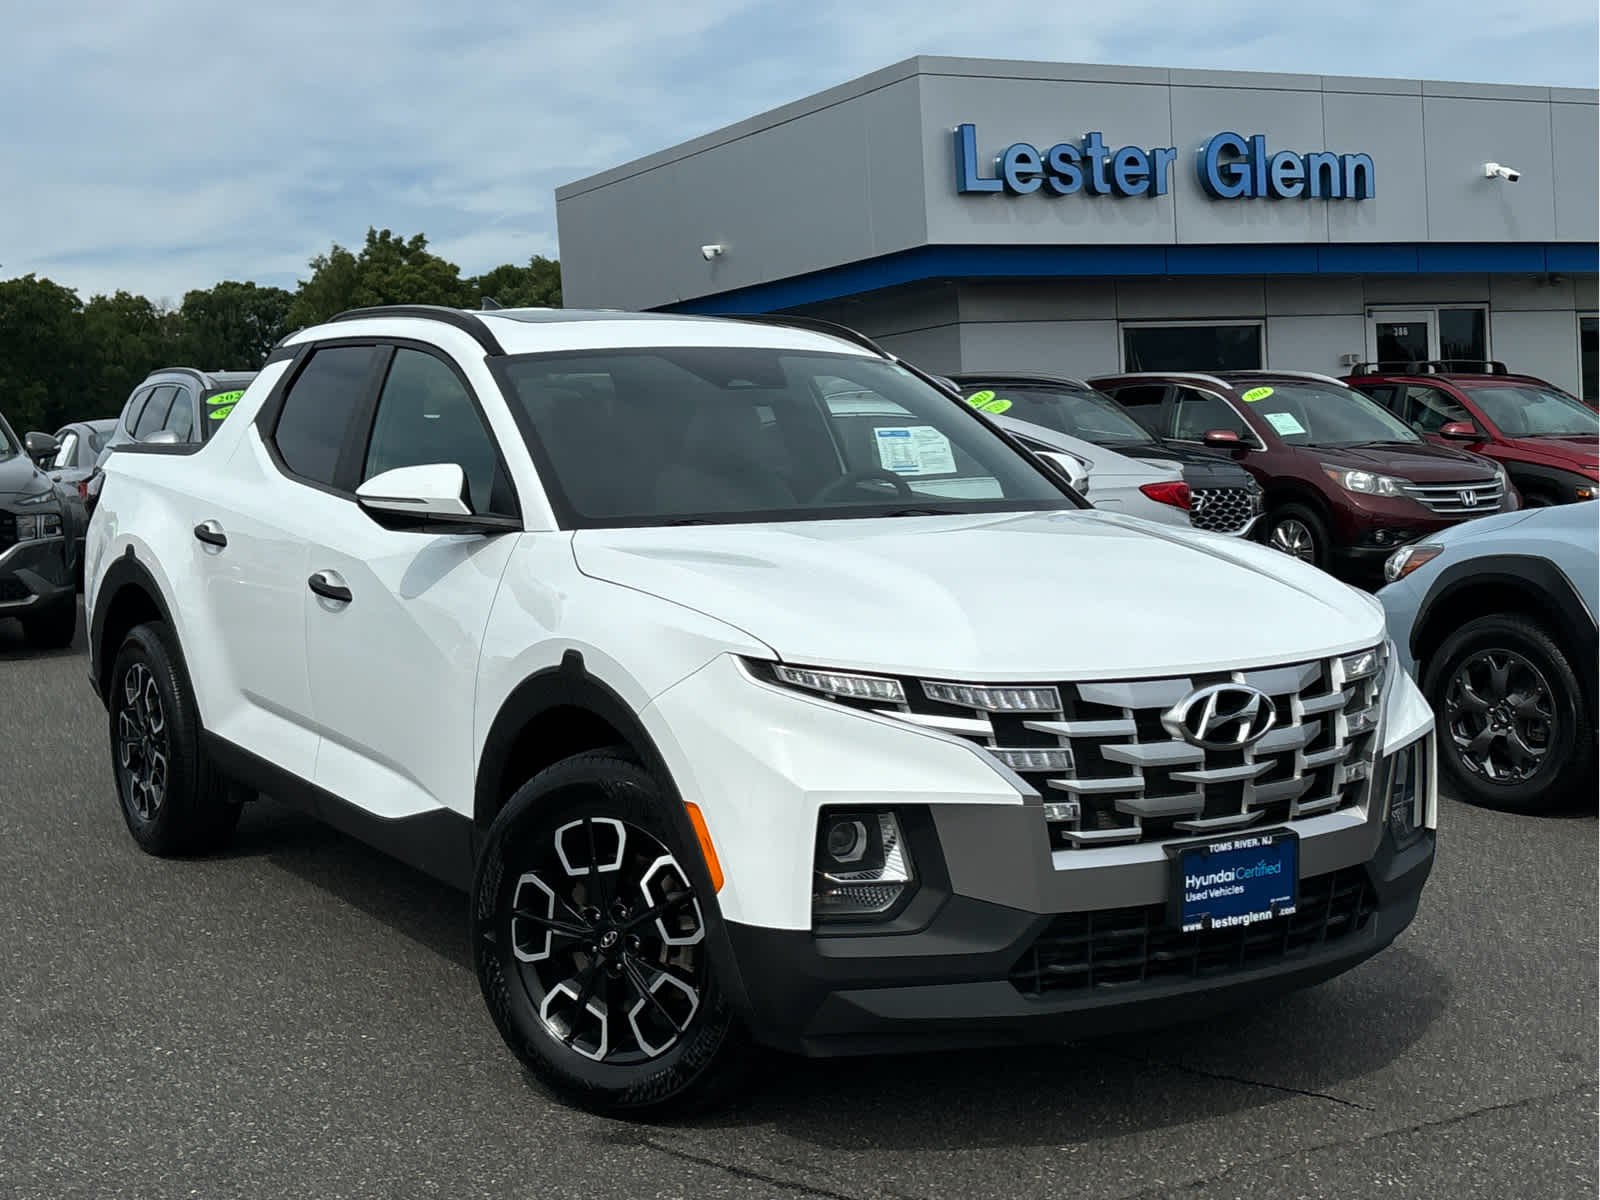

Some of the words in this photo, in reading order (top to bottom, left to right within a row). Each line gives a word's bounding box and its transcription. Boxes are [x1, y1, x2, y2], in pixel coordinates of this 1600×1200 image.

[954, 123, 1177, 196] Lester
[1198, 131, 1376, 200] Glenn
[1208, 842, 1233, 853] TOMS
[1261, 835, 1273, 846] NJ
[1185, 868, 1235, 889] Hyundai
[1235, 860, 1281, 880] Certified
[1185, 890, 1208, 902] Used
[1208, 885, 1245, 898] Vehicles
[1211, 910, 1273, 929] lesterglenn
